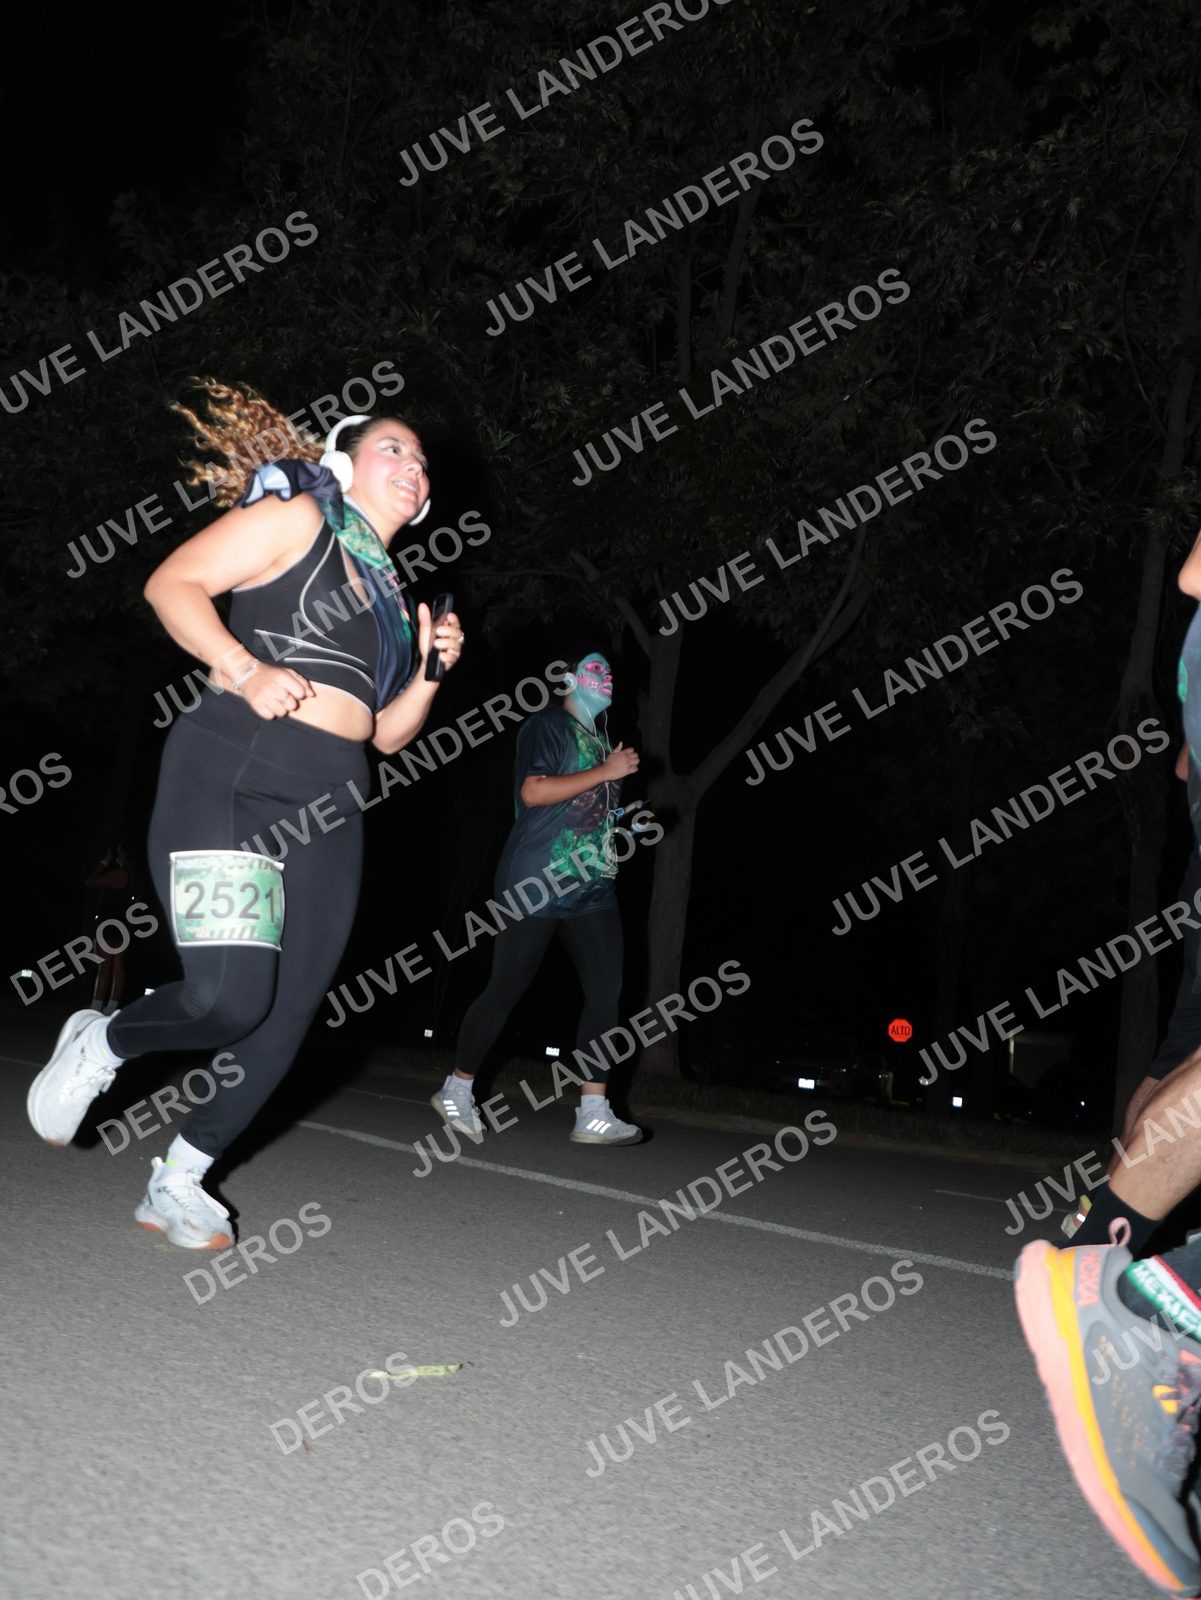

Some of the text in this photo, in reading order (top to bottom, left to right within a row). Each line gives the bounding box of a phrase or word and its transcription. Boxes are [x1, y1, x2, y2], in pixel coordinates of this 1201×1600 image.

[184, 880, 275, 923] 2521
[891, 1025, 911, 1036] ALTO
[1132, 1262, 1201, 1340] MEXIC
